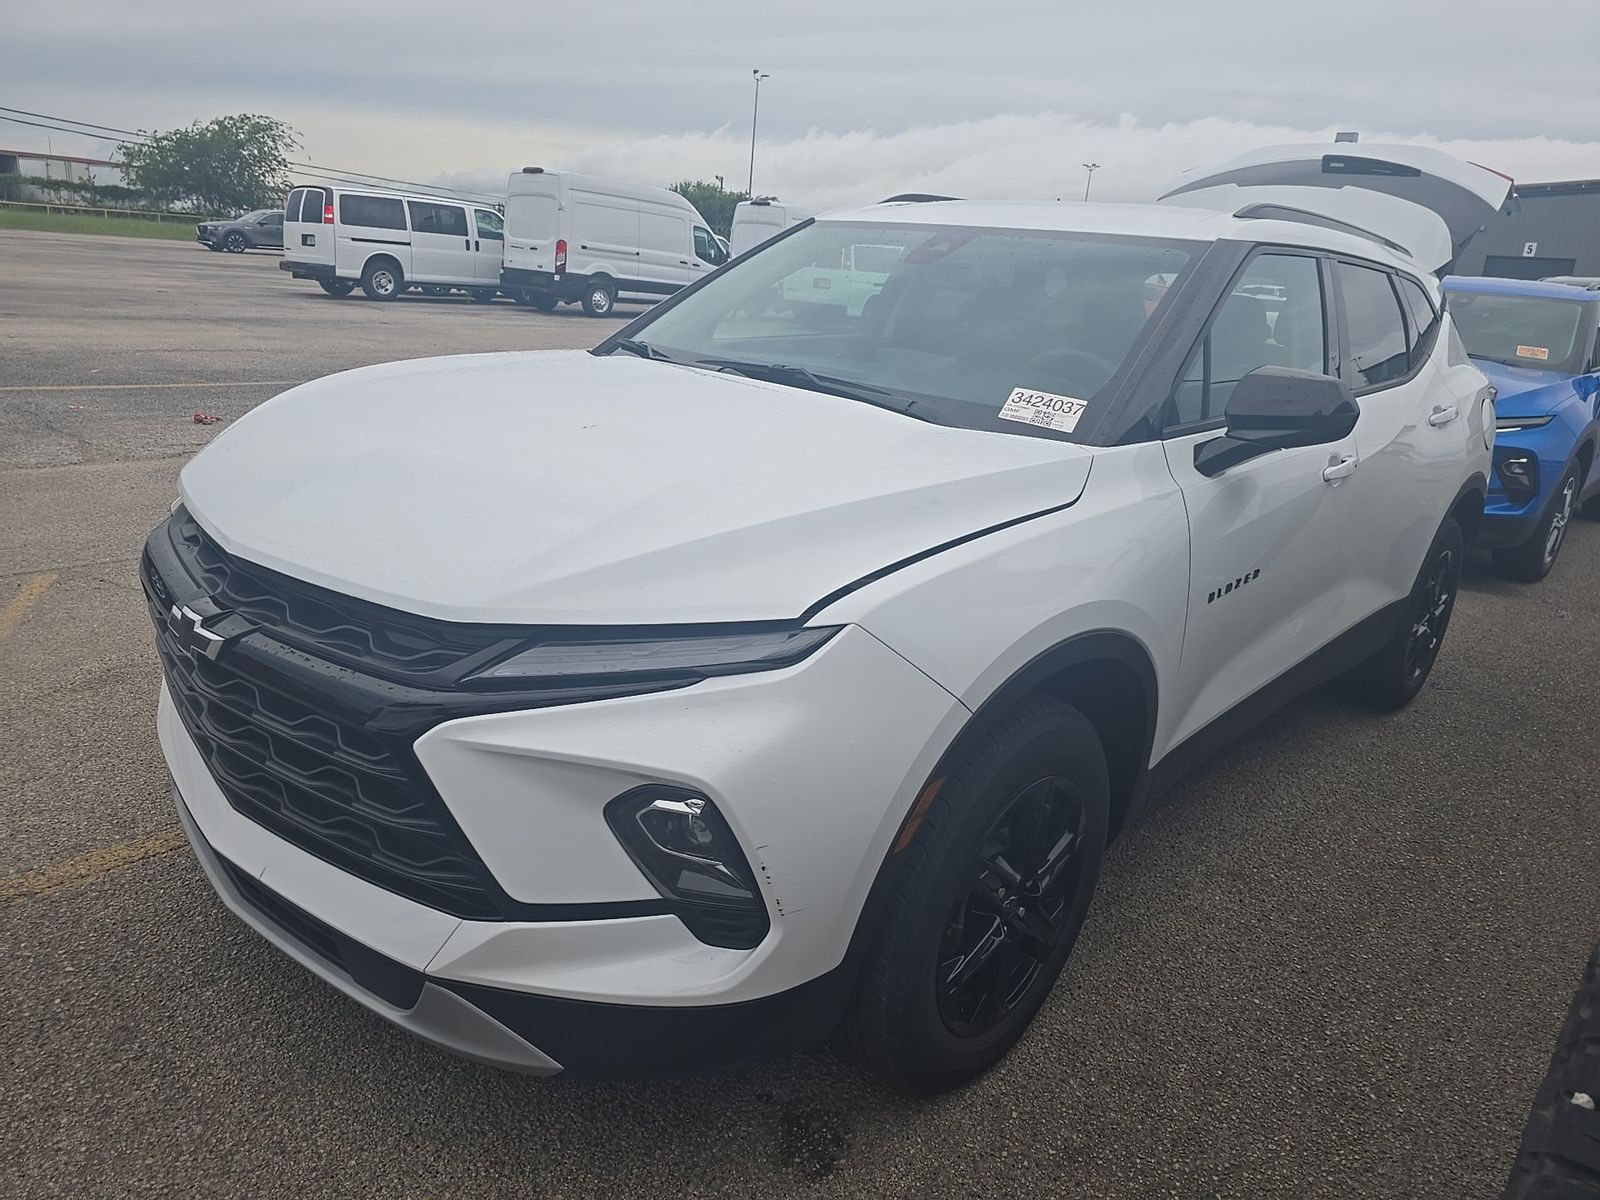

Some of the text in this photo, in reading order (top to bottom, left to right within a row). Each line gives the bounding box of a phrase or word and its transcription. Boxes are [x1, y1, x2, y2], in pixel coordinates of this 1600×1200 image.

[1526, 245, 1533, 254] 5
[1011, 392, 1085, 415] 3424037
[1208, 568, 1260, 604] BLAZER
